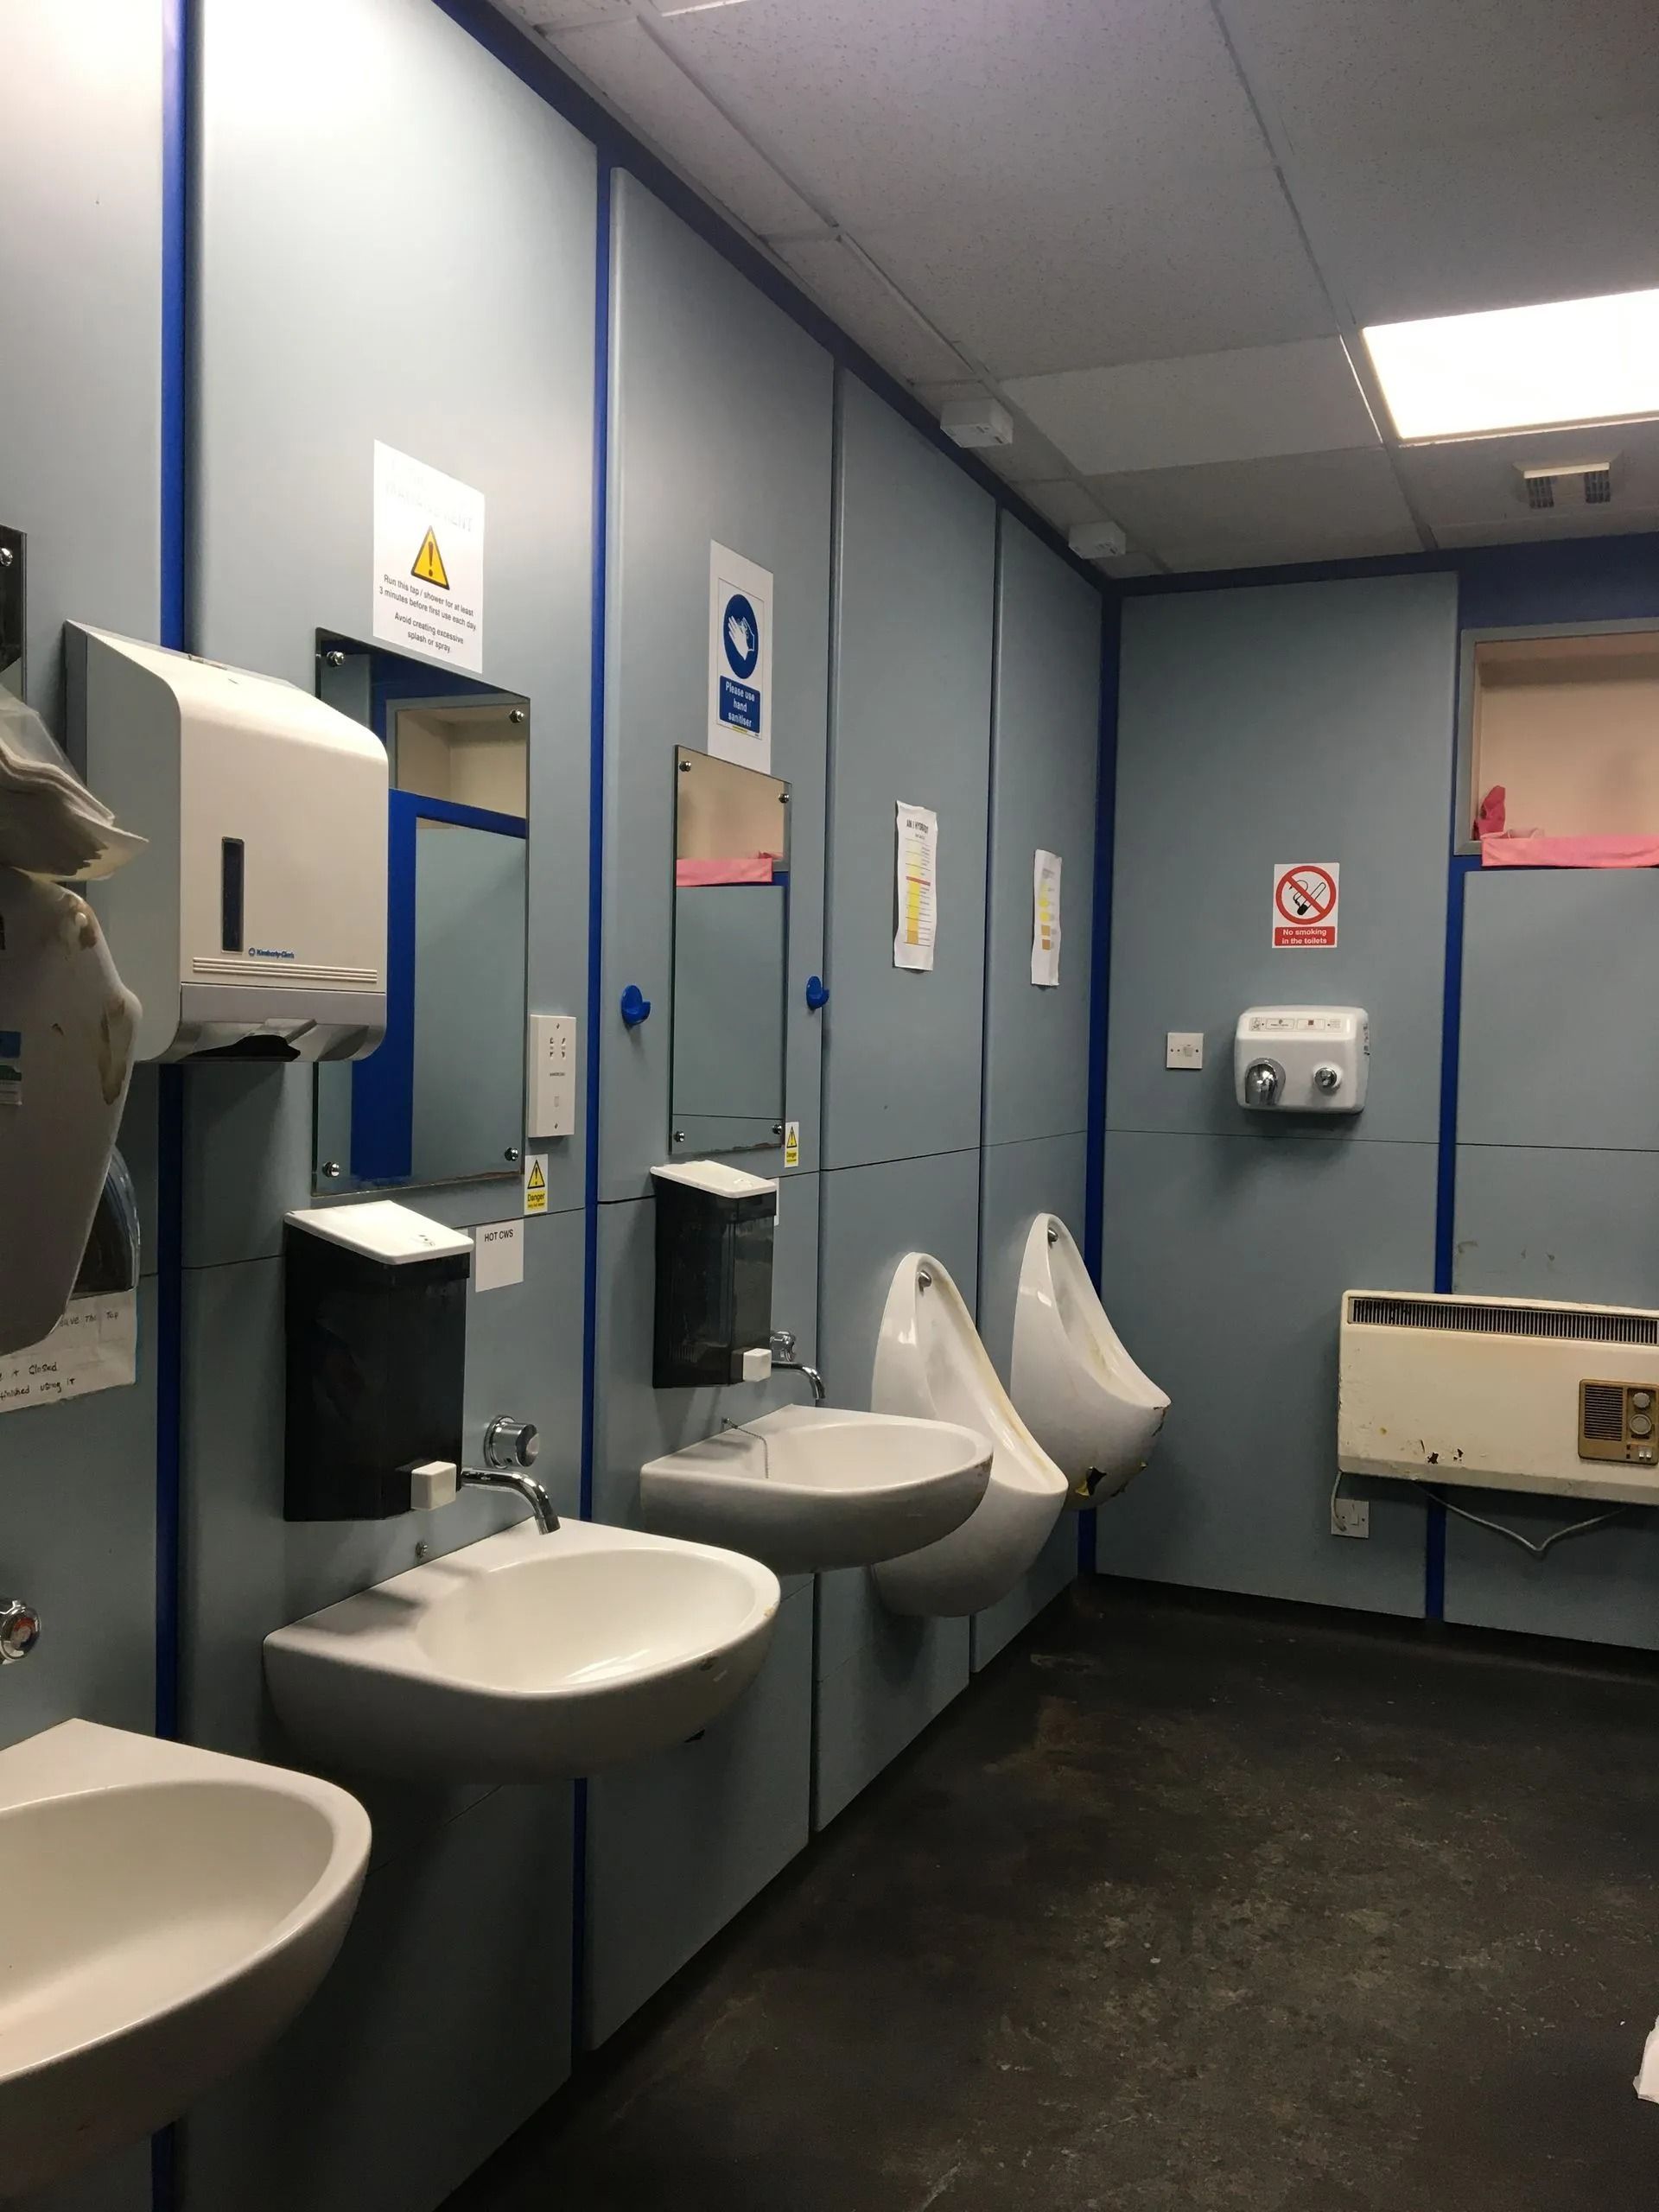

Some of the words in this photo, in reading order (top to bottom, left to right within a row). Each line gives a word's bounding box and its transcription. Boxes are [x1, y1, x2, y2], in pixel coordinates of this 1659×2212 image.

[384, 574, 397, 586] Run
[397, 579, 409, 591] this
[410, 585, 419, 596] tap
[423, 591, 444, 604] shower
[454, 602, 460, 611] at
[461, 605, 474, 617] least
[379, 586, 384, 594] 3
[385, 589, 408, 604] minutes
[410, 598, 428, 612] before
[429, 605, 440, 618] first
[441, 611, 451, 620] use
[452, 614, 465, 626] each
[467, 620, 476, 632] day
[395, 612, 411, 625] Avoid
[412, 618, 435, 636] creating
[436, 628, 463, 644] excessive
[407, 631, 427, 643] splash
[435, 640, 450, 653] spray
[725, 681, 744, 696] Please
[745, 690, 755, 702] use
[733, 697, 747, 713] hand
[728, 711, 752, 728] sanitiser
[527, 1192, 545, 1202] Danger
[484, 1231, 498, 1242] HOT
[499, 1229, 513, 1239] CWS
